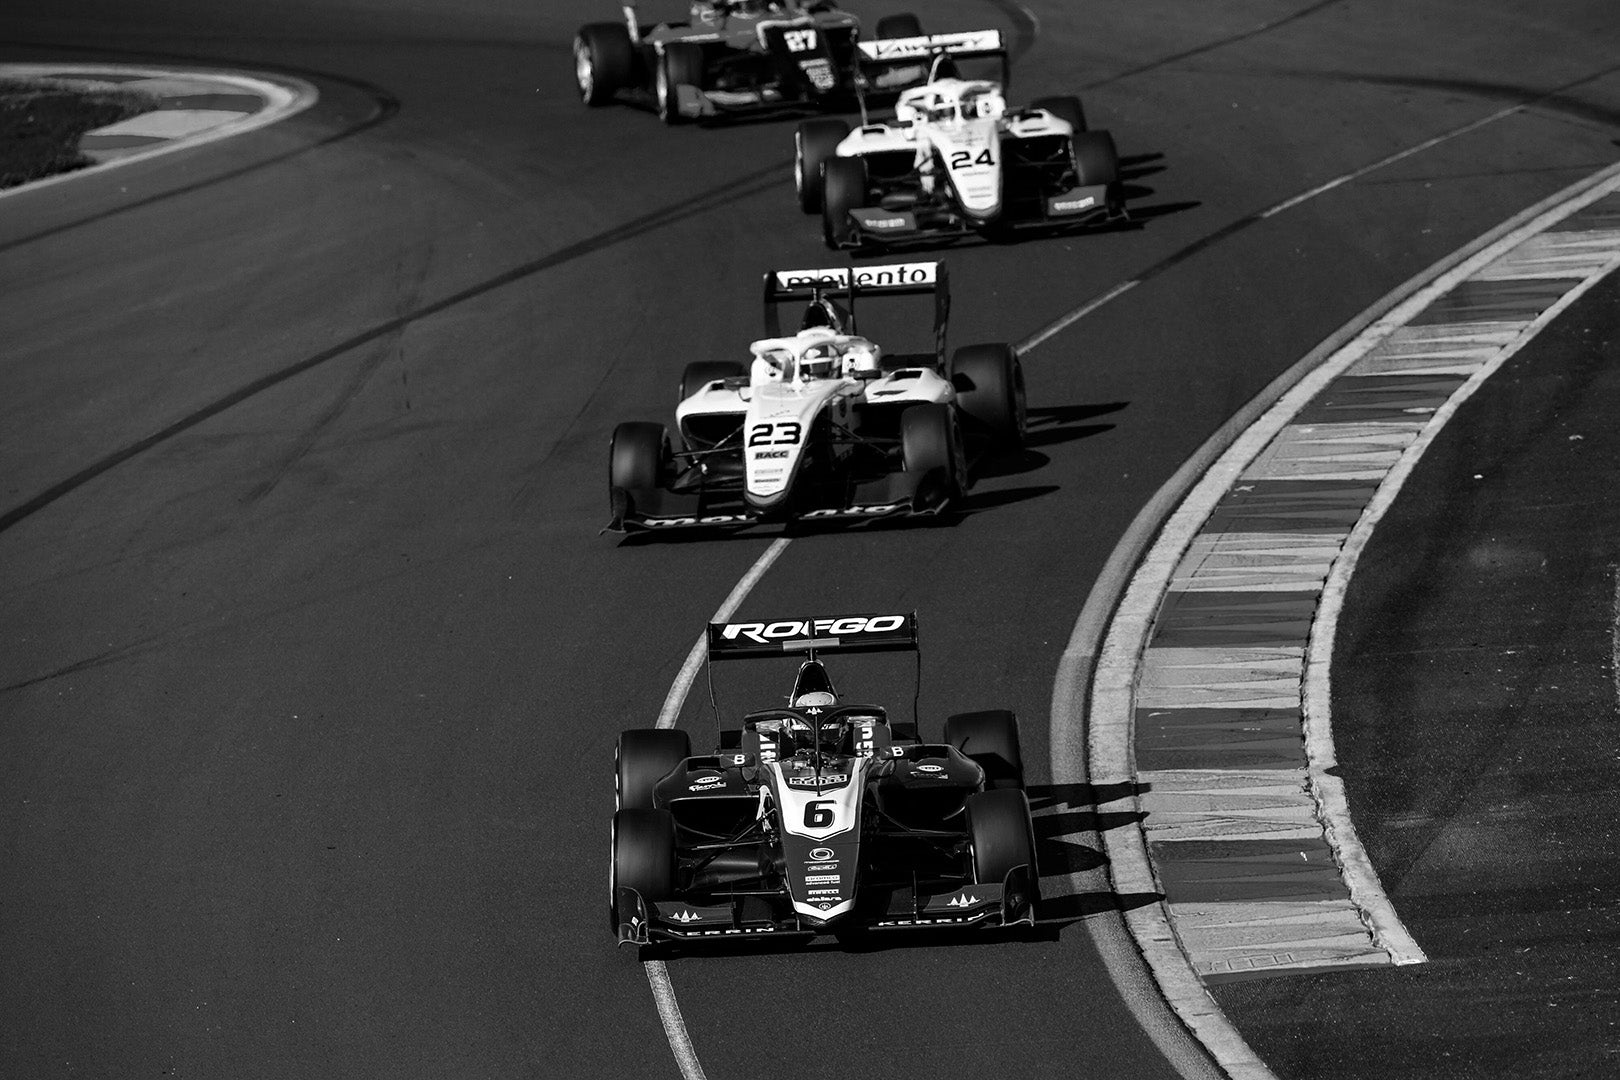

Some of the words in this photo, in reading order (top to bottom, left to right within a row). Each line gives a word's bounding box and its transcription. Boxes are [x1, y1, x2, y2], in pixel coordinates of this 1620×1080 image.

[951, 149, 995, 170] 24
[748, 422, 801, 448] 23
[755, 450, 789, 460] RACC
[722, 615, 905, 643] ROFGO
[734, 754, 746, 765] B
[891, 746, 904, 757] B
[803, 799, 837, 828] 6
